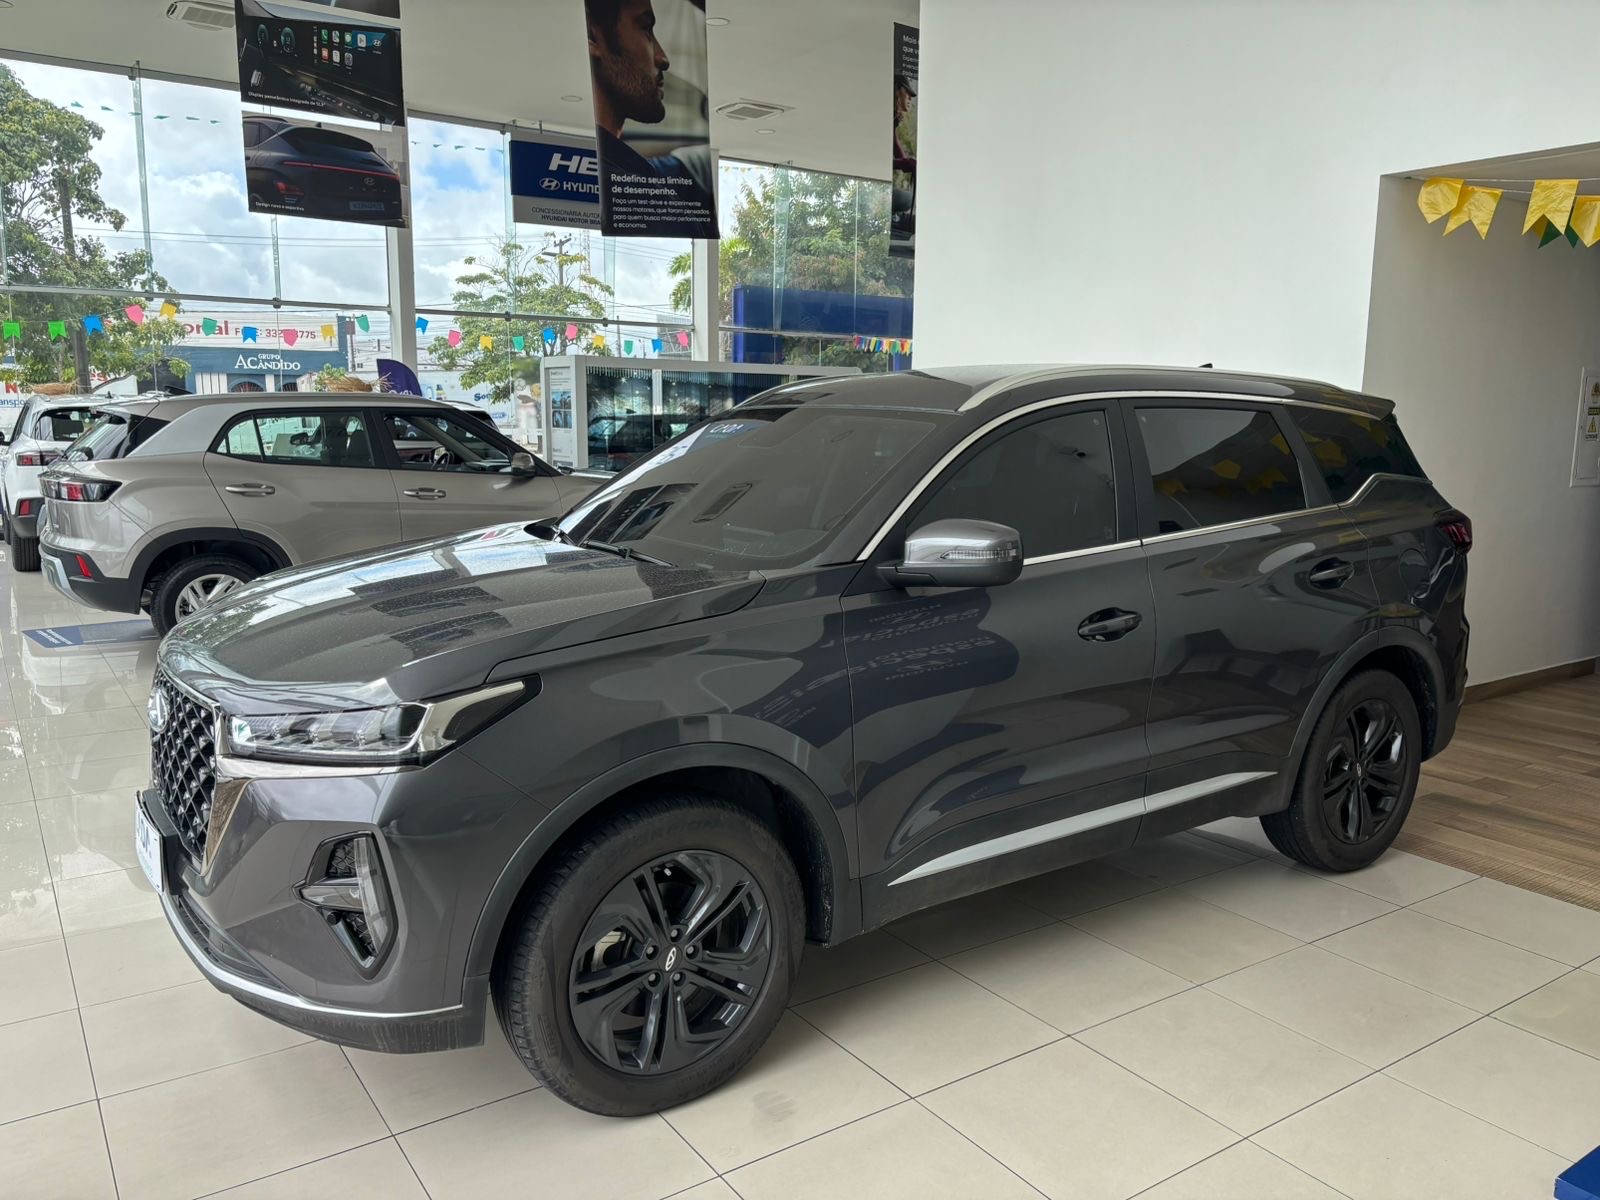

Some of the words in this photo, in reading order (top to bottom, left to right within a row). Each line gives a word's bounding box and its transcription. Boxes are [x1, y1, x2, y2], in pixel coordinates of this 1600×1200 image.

[611, 174, 646, 183] Redefina
[667, 176, 693, 185] limites
[612, 185, 622, 193] de
[624, 186, 678, 196] desempenho.
[532, 206, 581, 217] CONCESSIONÁRIA
